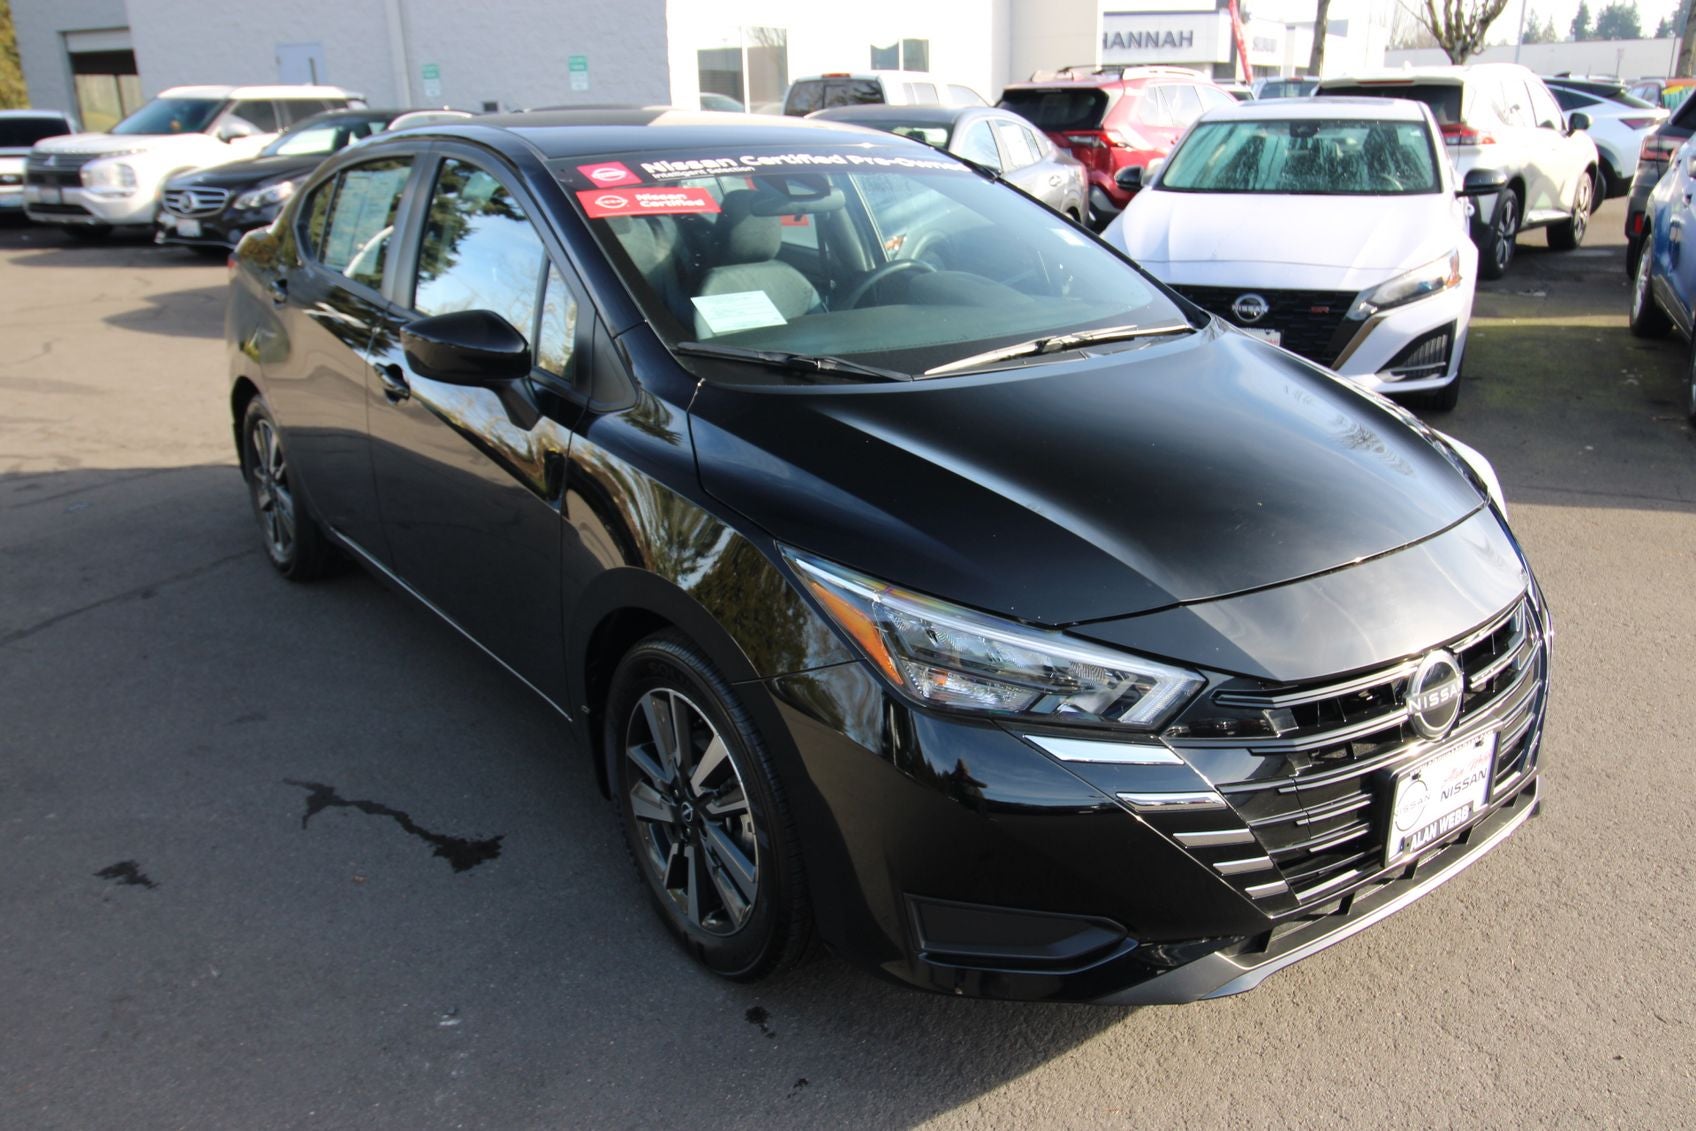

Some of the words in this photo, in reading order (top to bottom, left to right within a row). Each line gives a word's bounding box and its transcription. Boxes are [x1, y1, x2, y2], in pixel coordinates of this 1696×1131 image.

[640, 157, 738, 174] Nissan
[739, 153, 847, 166] Certified
[652, 168, 706, 180] Intelligent
[707, 165, 756, 175] Selection
[635, 193, 687, 201] Nissan
[639, 199, 705, 208] Certified
[1408, 681, 1460, 715] NISSA
[1440, 767, 1488, 801] NISSAN
[1410, 821, 1438, 853] ALAN
[1438, 805, 1470, 835] WEBB
